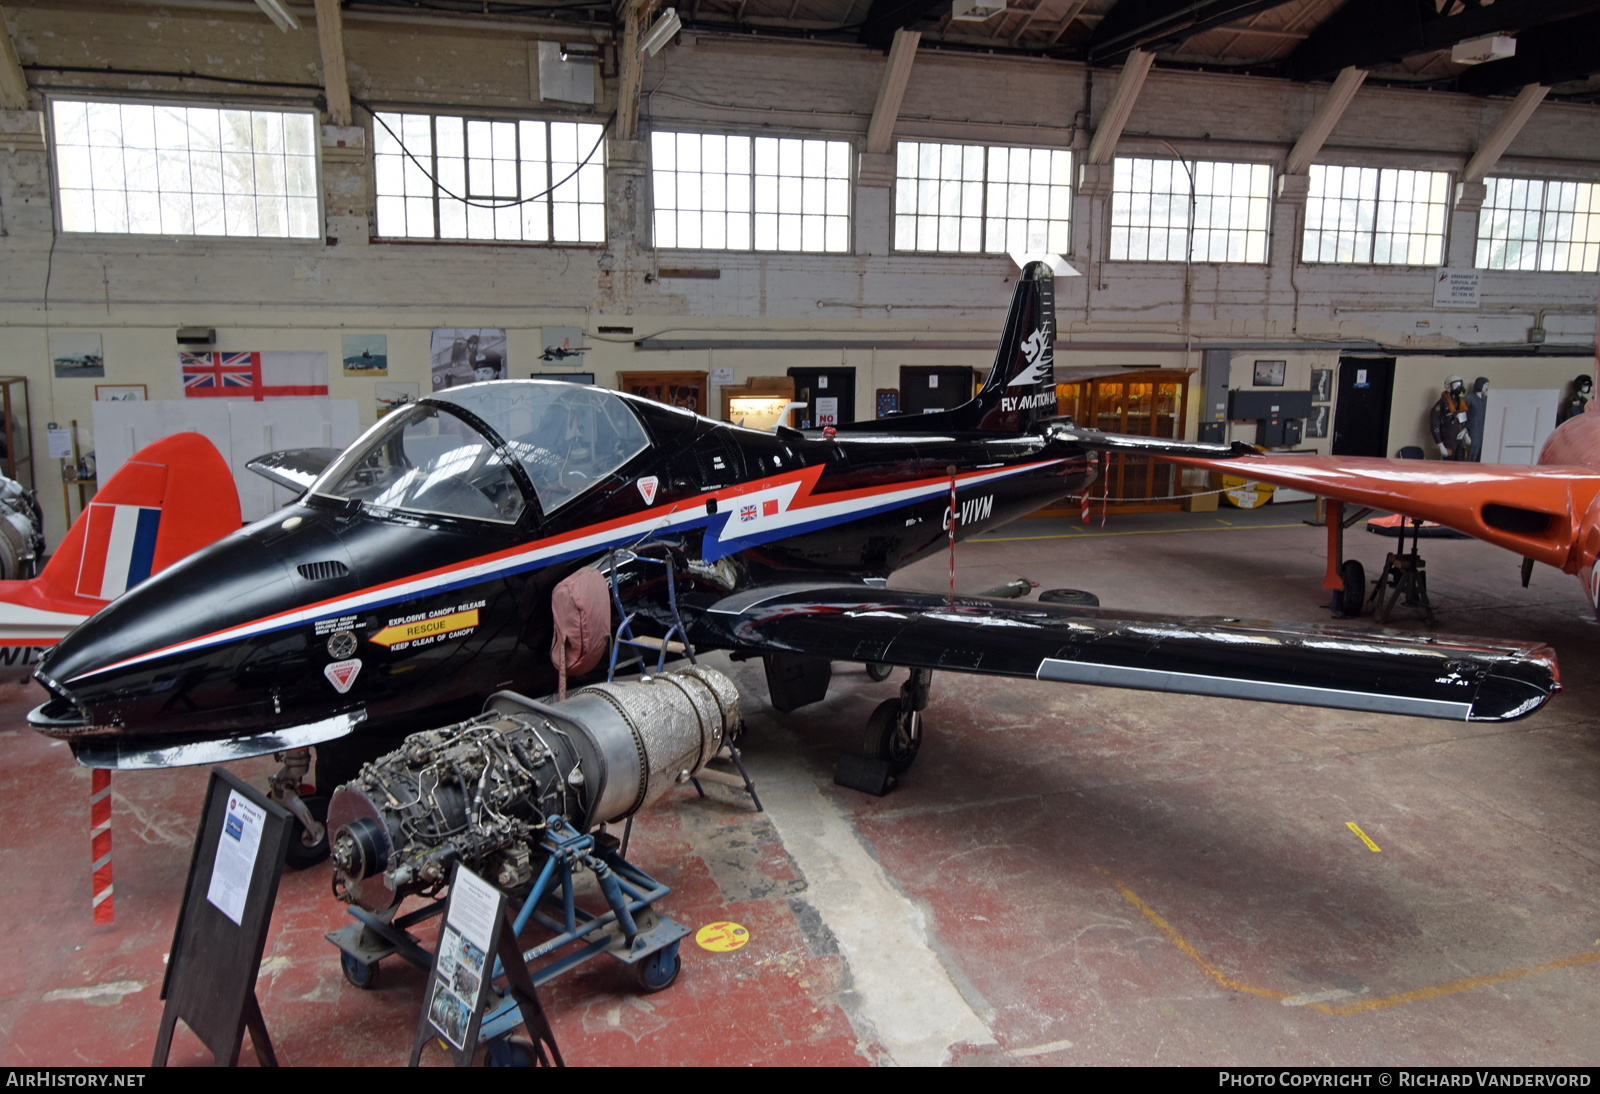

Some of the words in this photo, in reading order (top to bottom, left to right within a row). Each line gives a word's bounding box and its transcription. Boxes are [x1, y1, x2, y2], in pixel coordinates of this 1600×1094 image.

[1001, 396, 1018, 412] FLY
[1018, 392, 1050, 410] AVIATION
[820, 414, 834, 423] NO
[942, 494, 994, 530] G-VIVM
[388, 613, 426, 626] EXPLOSIVE
[429, 606, 456, 618] CANOPY
[458, 600, 486, 612] RELEASE
[407, 620, 446, 636] RESCUE
[390, 642, 409, 652] KEEP
[412, 637, 434, 648] CLEAR
[448, 627, 474, 639] CANOPY
[331, 660, 355, 669] DANGER
